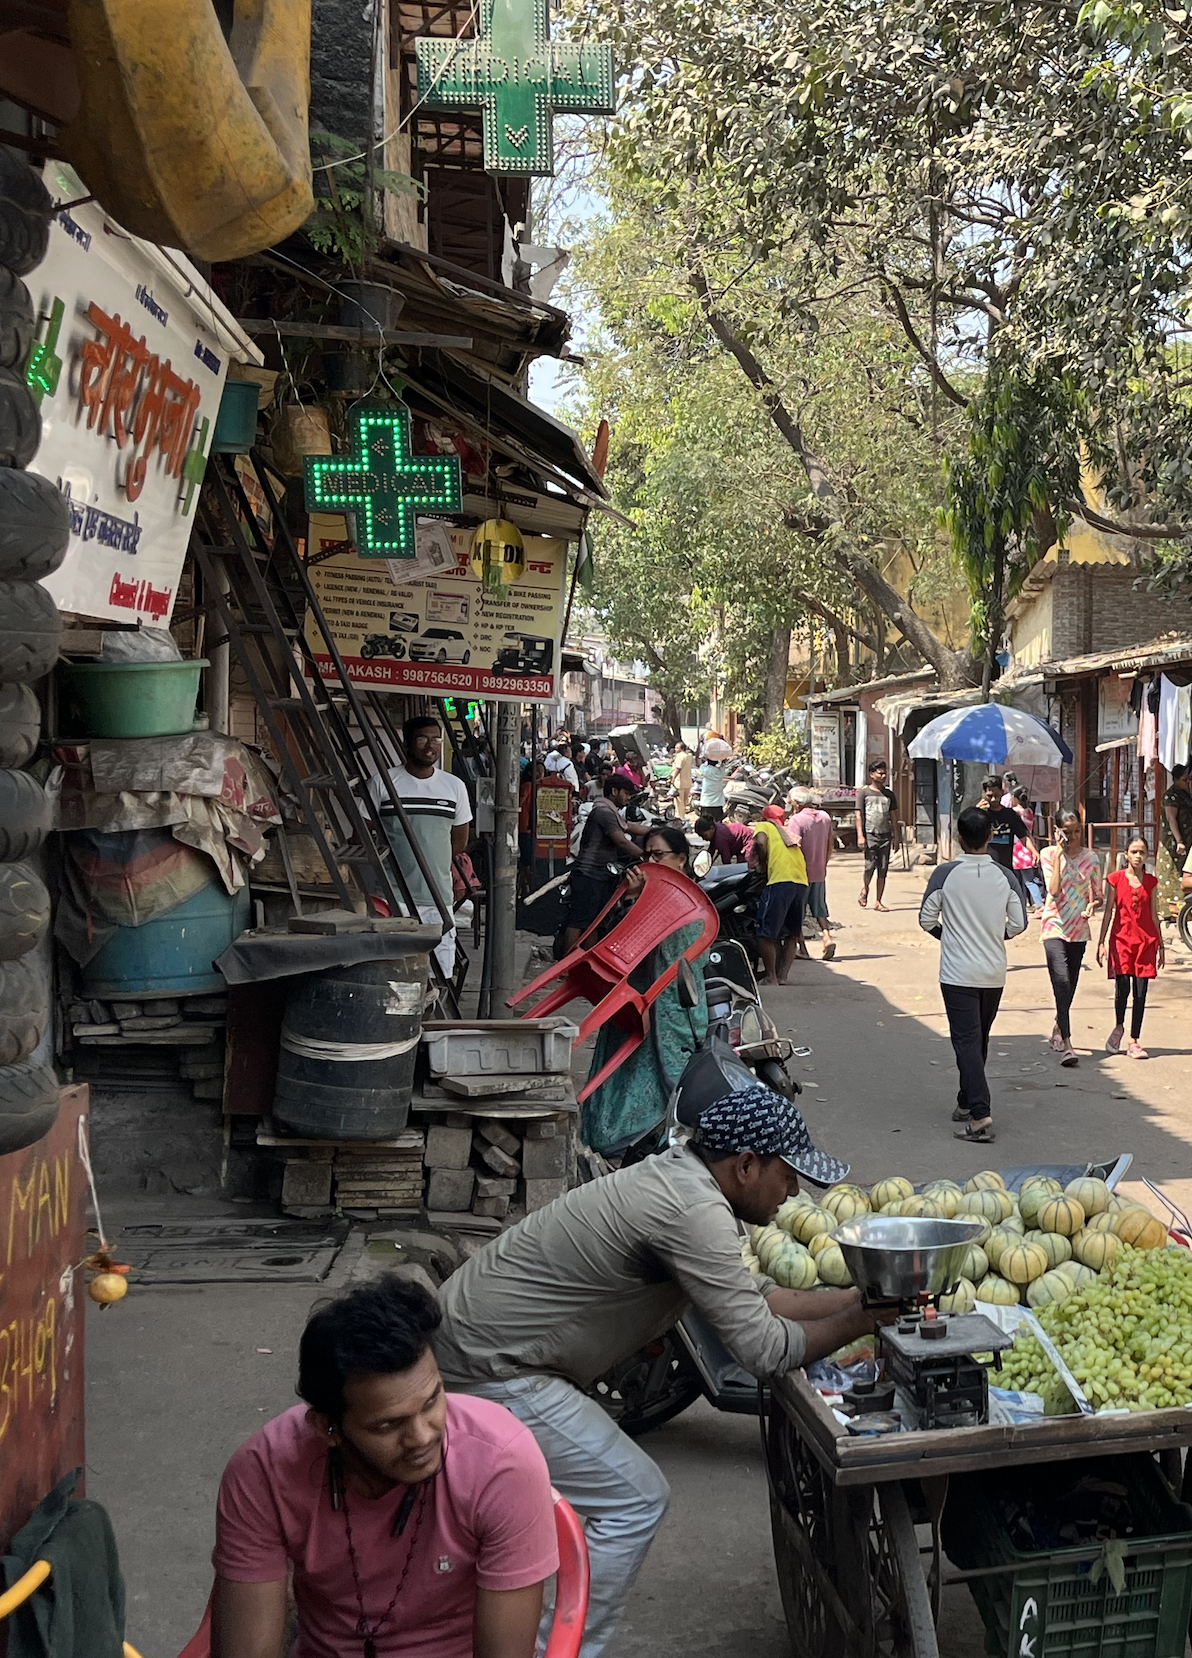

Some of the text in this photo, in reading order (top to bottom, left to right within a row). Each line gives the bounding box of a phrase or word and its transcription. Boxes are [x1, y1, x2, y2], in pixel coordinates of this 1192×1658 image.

[431, 55, 600, 88] MEDICAL
[80, 301, 201, 502] चारभुजा
[322, 471, 443, 494] MEDICAL
[344, 573, 366, 582] PASSING
[362, 587, 386, 596] RENEWAL
[527, 592, 551, 600] PASSING
[332, 596, 348, 604] TYPES
[355, 598, 376, 606] VEHICLE
[376, 600, 404, 609] INSURANCE
[484, 600, 511, 608] TRANSFER
[520, 603, 554, 612] OWNERSHIP
[322, 607, 341, 615] PERMIT
[360, 610, 386, 620] RENEWAL)
[495, 612, 535, 622] REGISTRATION
[351, 622, 369, 630] BADGE
[402, 668, 473, 687] 9987564520
[482, 676, 551, 693] 9892963350
[500, 716, 518, 728] 73
[7, 1148, 69, 1266] MAN
